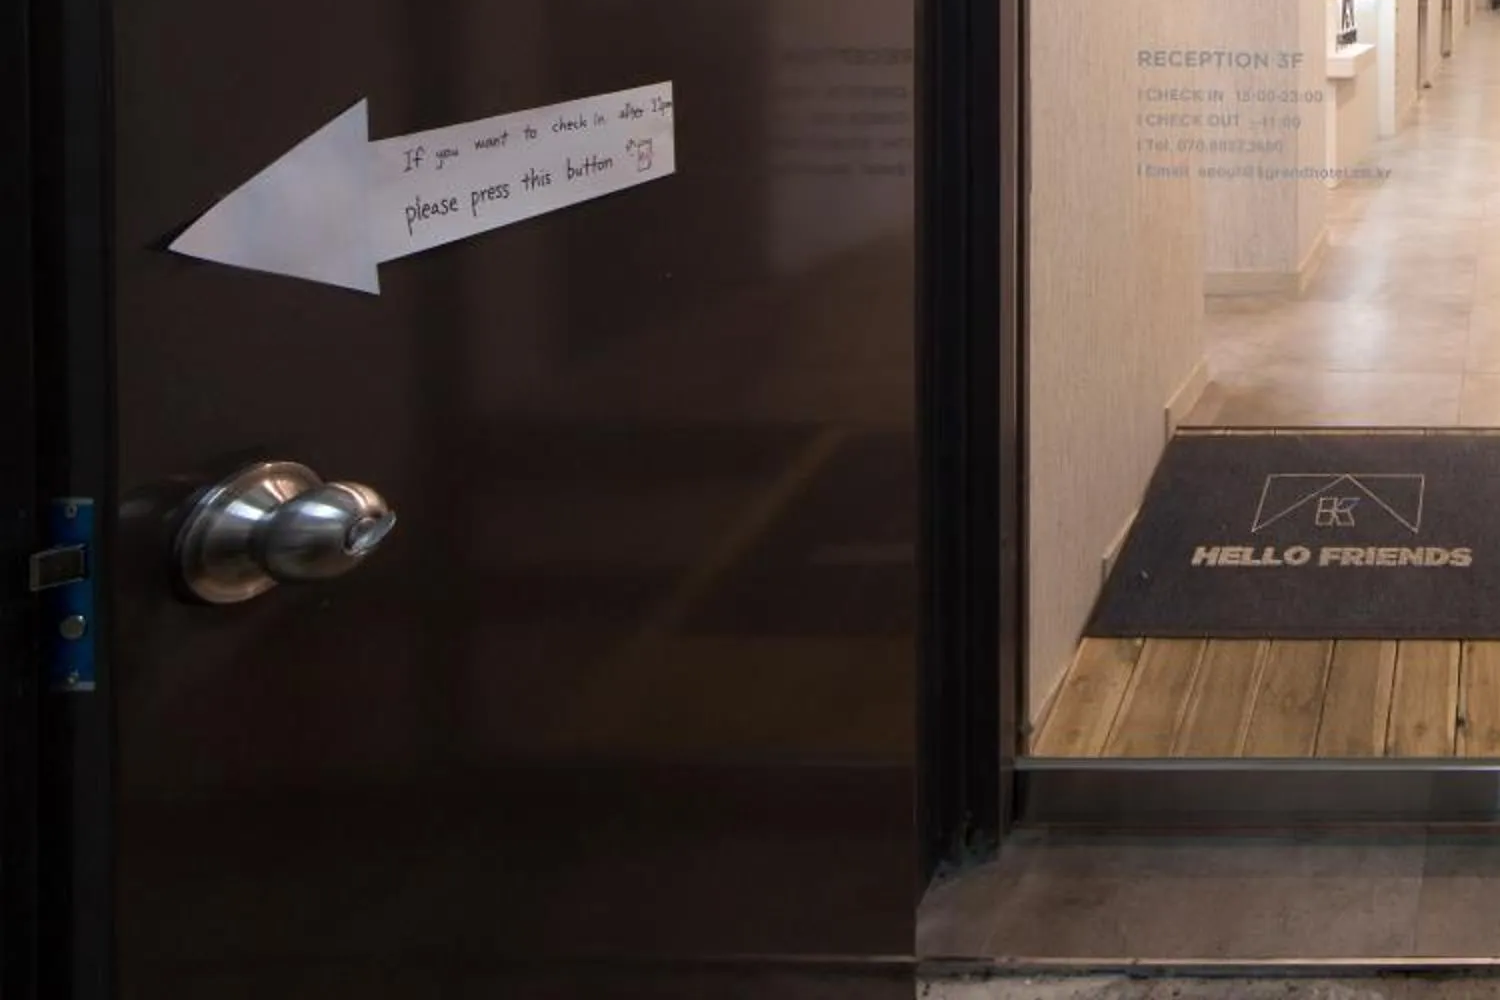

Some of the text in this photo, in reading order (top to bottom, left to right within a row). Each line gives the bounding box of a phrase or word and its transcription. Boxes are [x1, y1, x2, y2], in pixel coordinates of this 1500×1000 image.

[1136, 50, 1304, 70] RECEPTION 3F
[1146, 87, 1202, 102] CHECK
[1207, 88, 1224, 102] IN
[1145, 113, 1202, 128] CHECK
[1207, 114, 1240, 128] OUT
[403, 145, 425, 172] If
[435, 147, 459, 170] you
[474, 131, 508, 150] want
[522, 125, 538, 141] to
[551, 115, 588, 134] check
[593, 110, 607, 127] in
[617, 102, 645, 120] after
[405, 156, 614, 237] please press this button
[1190, 546, 1473, 568] HELLO FRIENDS
